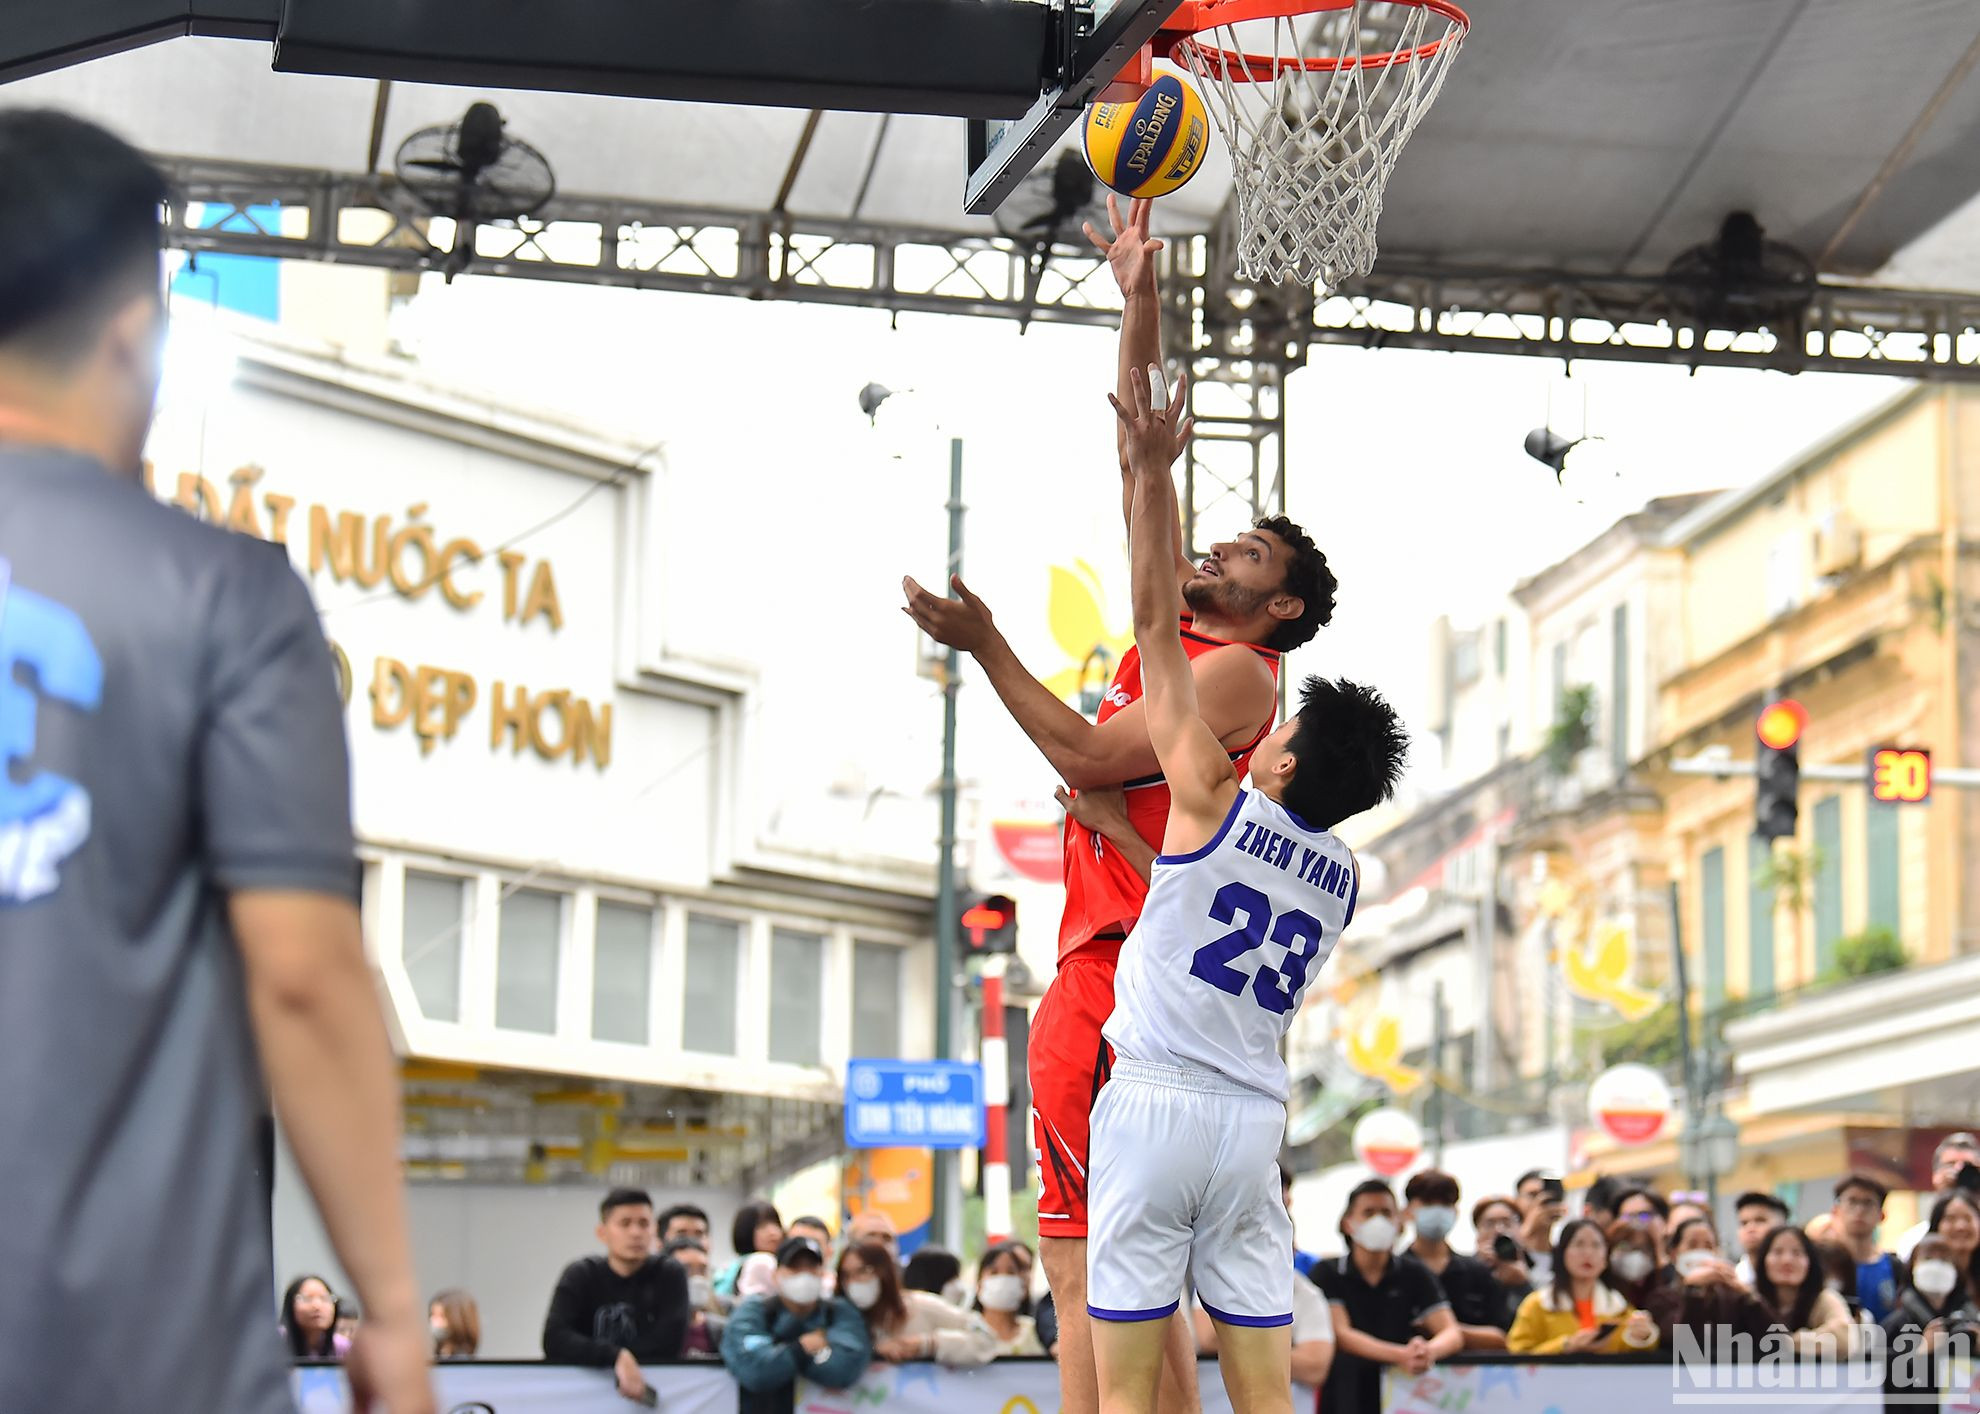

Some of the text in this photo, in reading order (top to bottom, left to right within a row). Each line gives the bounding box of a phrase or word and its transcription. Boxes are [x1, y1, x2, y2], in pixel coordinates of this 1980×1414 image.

[1127, 92, 1177, 174] SPALDING
[498, 551, 565, 630] TA
[369, 656, 477, 756] ĐẸP
[490, 681, 612, 768] HƠN
[1873, 749, 1930, 802] 30
[1234, 820, 1350, 900] ZHEN YANG
[1189, 881, 1323, 1016] 23
